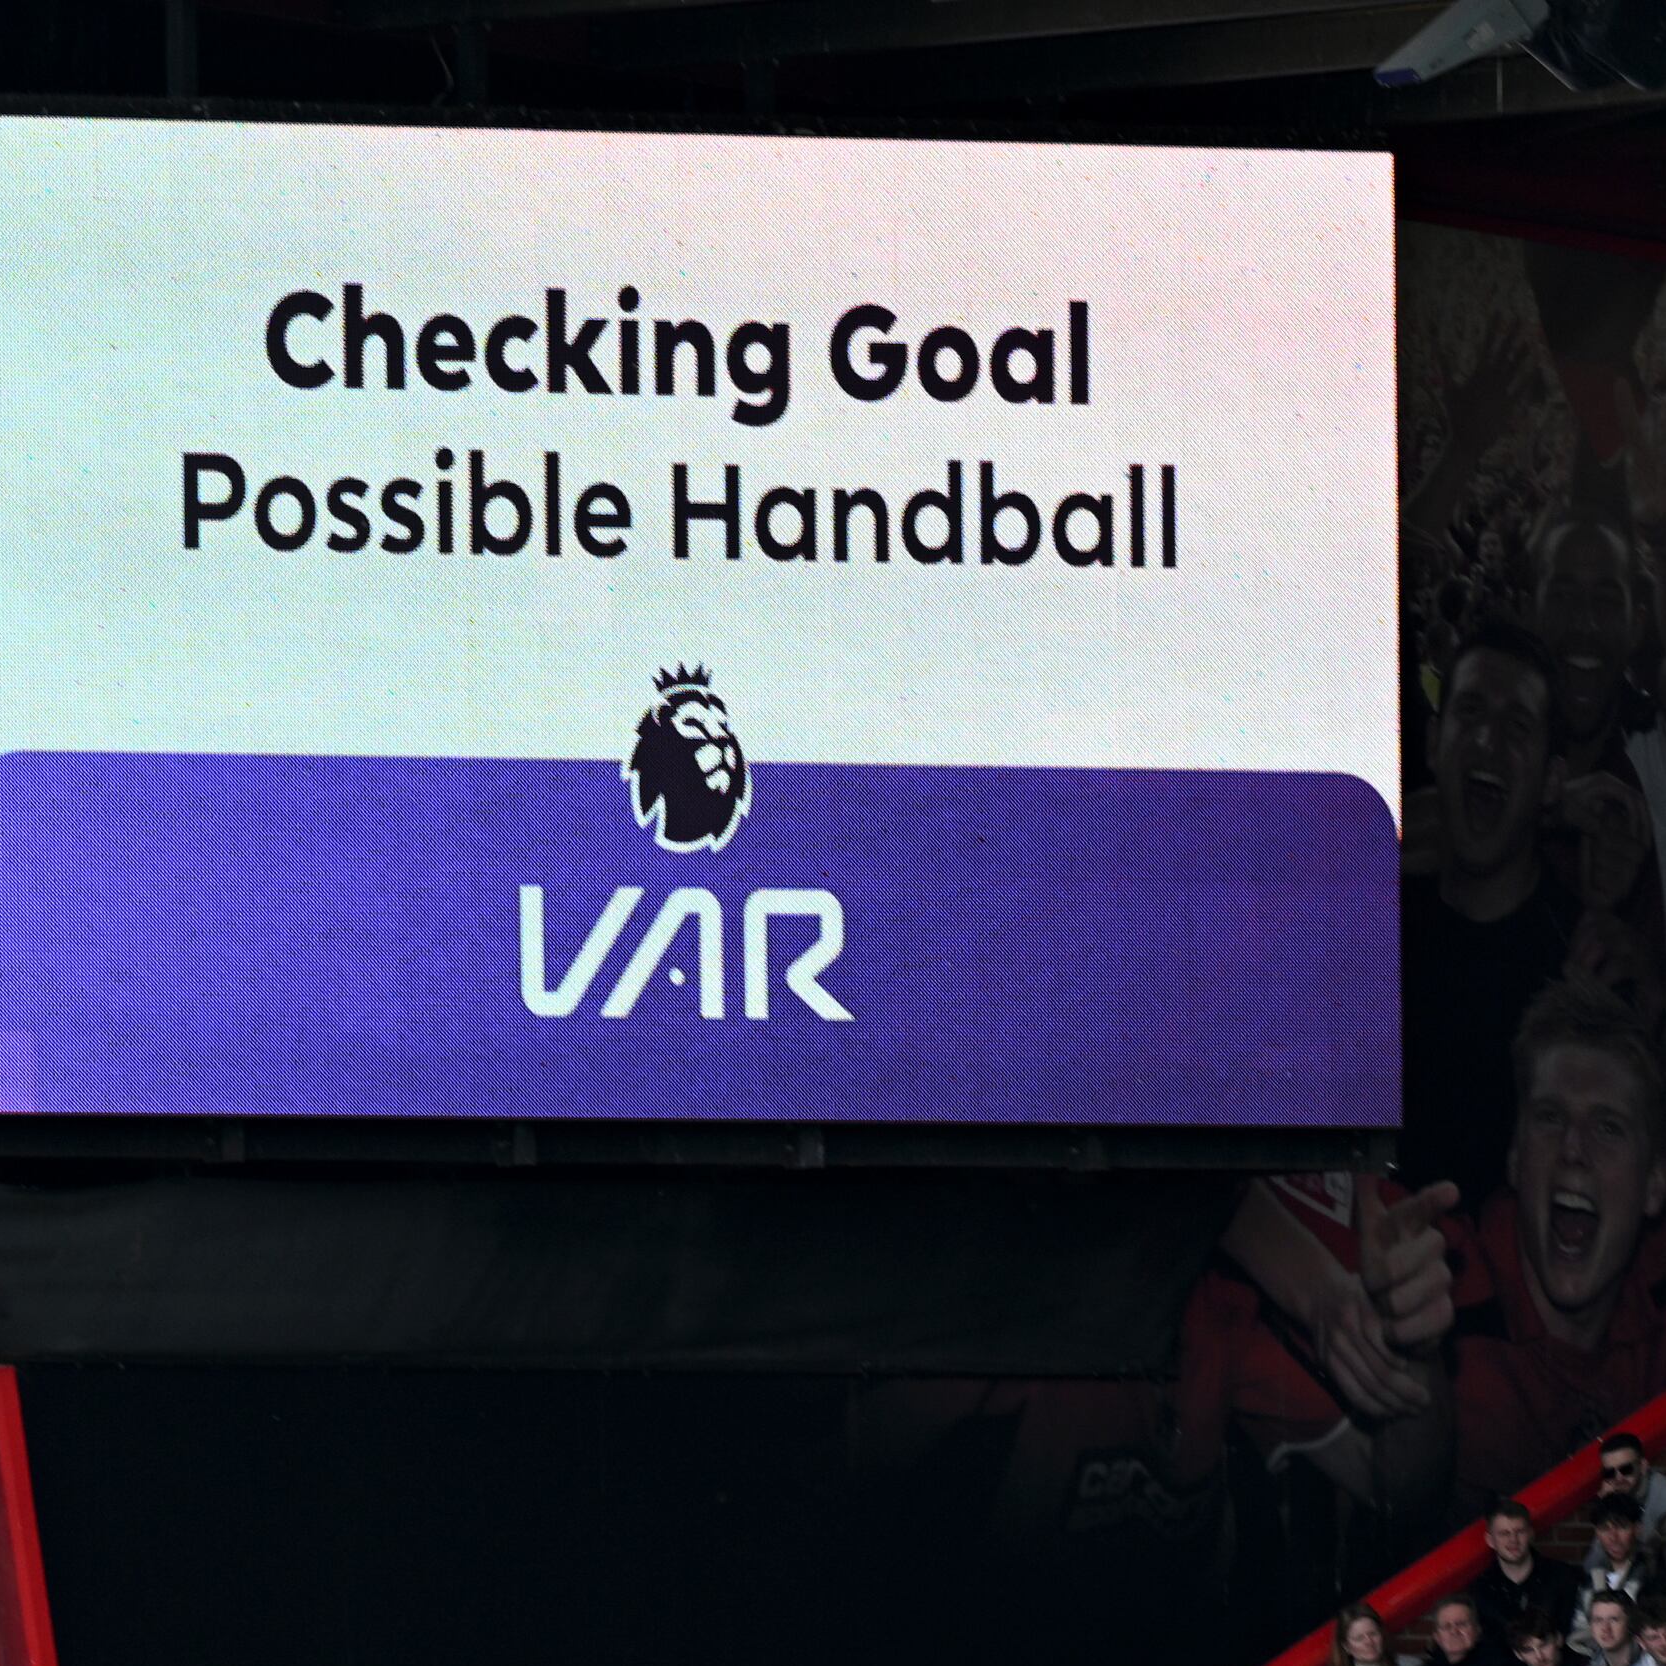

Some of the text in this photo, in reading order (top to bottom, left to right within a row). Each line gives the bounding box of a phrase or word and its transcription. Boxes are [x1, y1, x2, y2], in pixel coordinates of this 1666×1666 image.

[265, 284, 1090, 427] Checking Goal
[181, 447, 1179, 570] Possible Handball
[518, 883, 855, 1022] VAR
